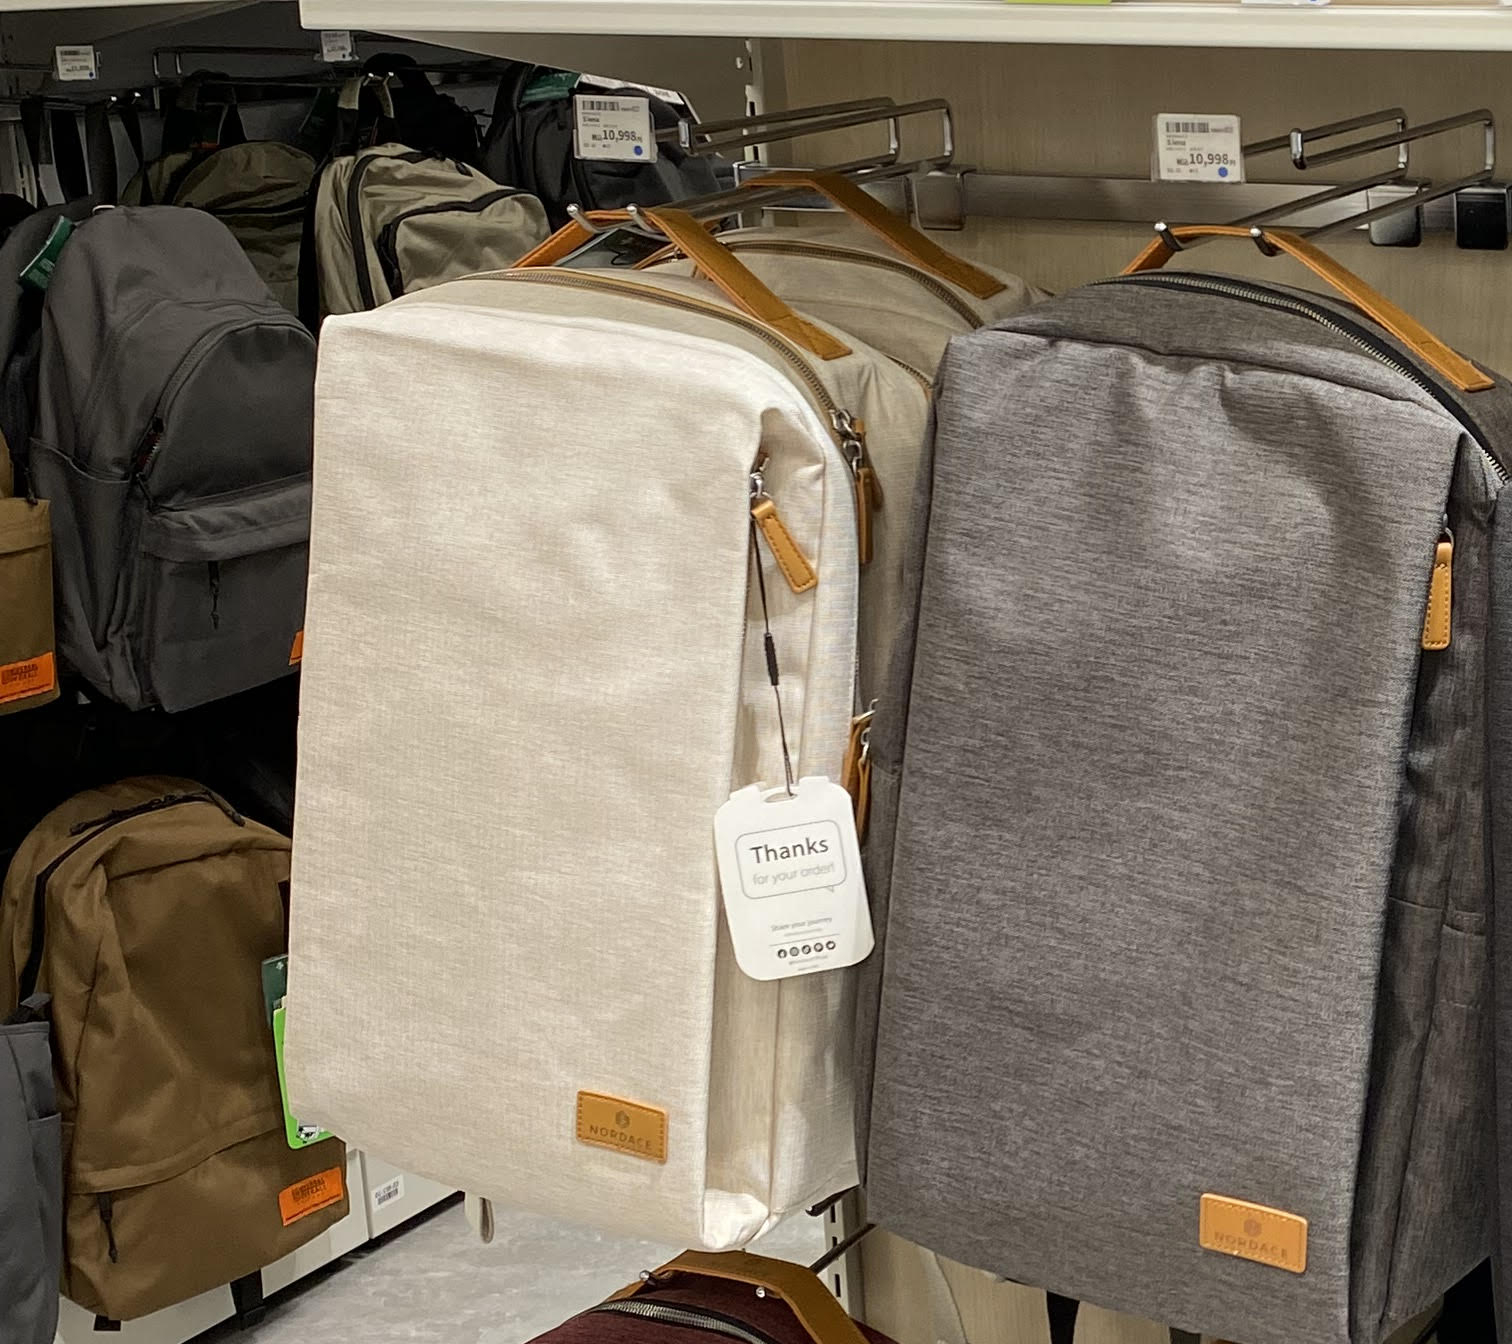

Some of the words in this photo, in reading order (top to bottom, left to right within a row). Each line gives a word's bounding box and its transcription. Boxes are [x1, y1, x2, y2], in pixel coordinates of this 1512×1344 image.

[749, 837, 829, 864] Thanks
[753, 872, 768, 885] for
[771, 870, 798, 885] your
[590, 1124, 652, 1150] NORDACE
[1214, 1232, 1287, 1259] NORDACE
